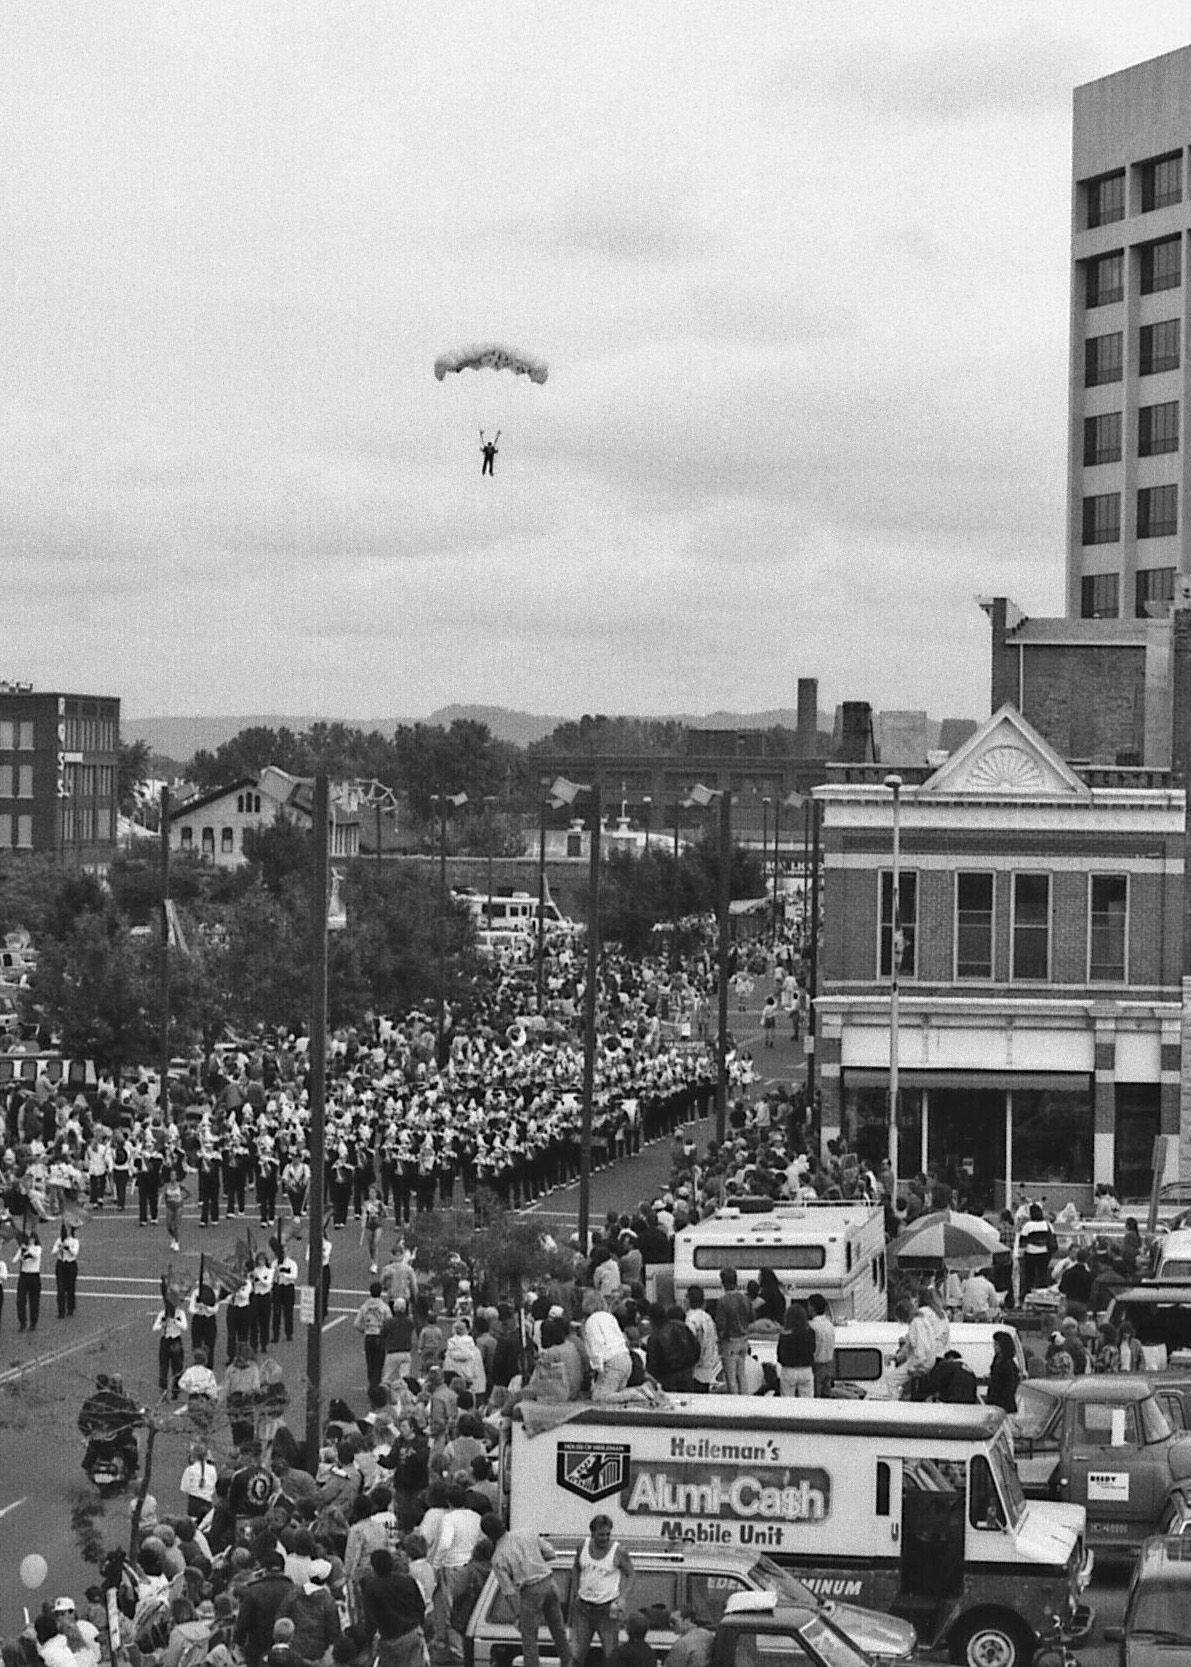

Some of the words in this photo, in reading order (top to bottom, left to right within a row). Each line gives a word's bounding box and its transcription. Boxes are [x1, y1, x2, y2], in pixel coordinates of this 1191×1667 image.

[670, 1437, 780, 1461] Heileman's
[660, 1521, 732, 1544] Mobile
[740, 1524, 784, 1546] Unit
